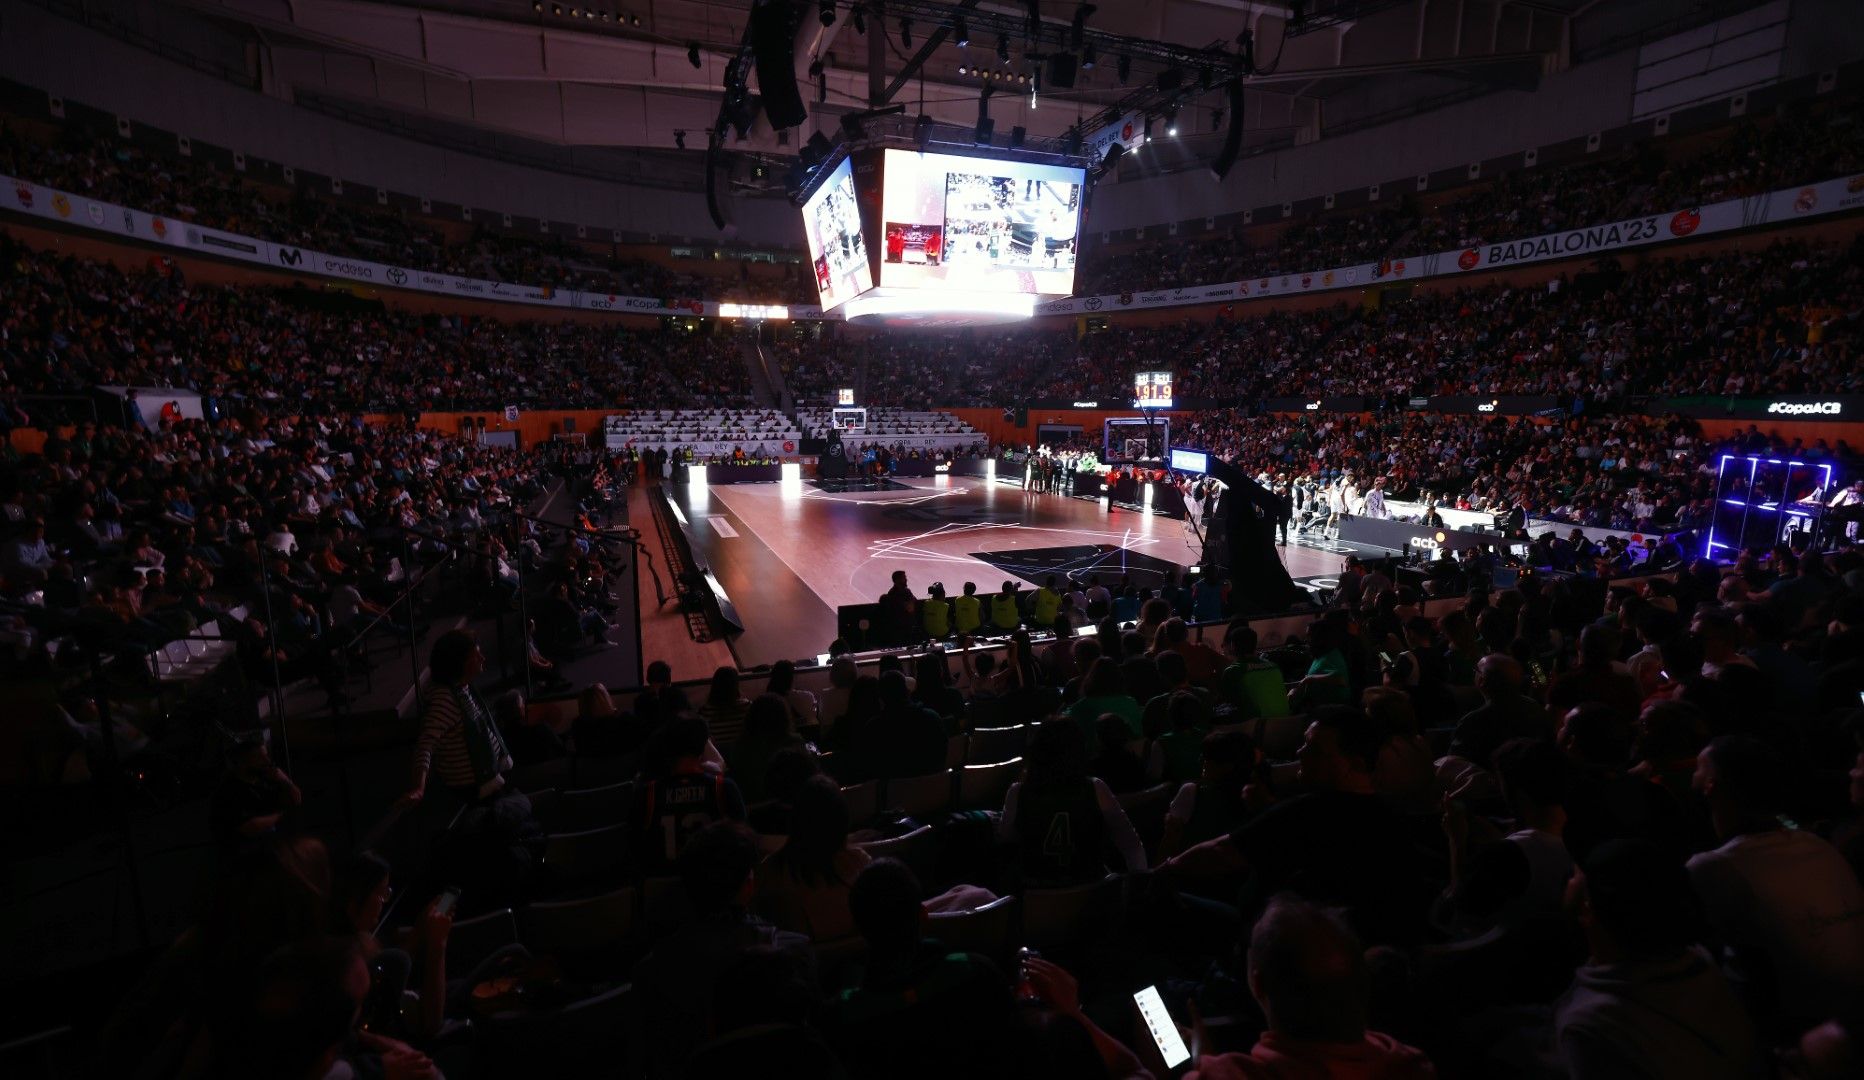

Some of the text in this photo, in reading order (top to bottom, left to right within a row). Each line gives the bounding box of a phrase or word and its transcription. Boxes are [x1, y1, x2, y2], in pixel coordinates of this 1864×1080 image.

[1488, 218, 1658, 264] BADALONA'23
[325, 259, 373, 279] endesa
[591, 297, 612, 309] acb
[1768, 402, 1842, 415] #CopaACB
[1410, 536, 1439, 549] acb
[1042, 810, 1072, 866] 4
